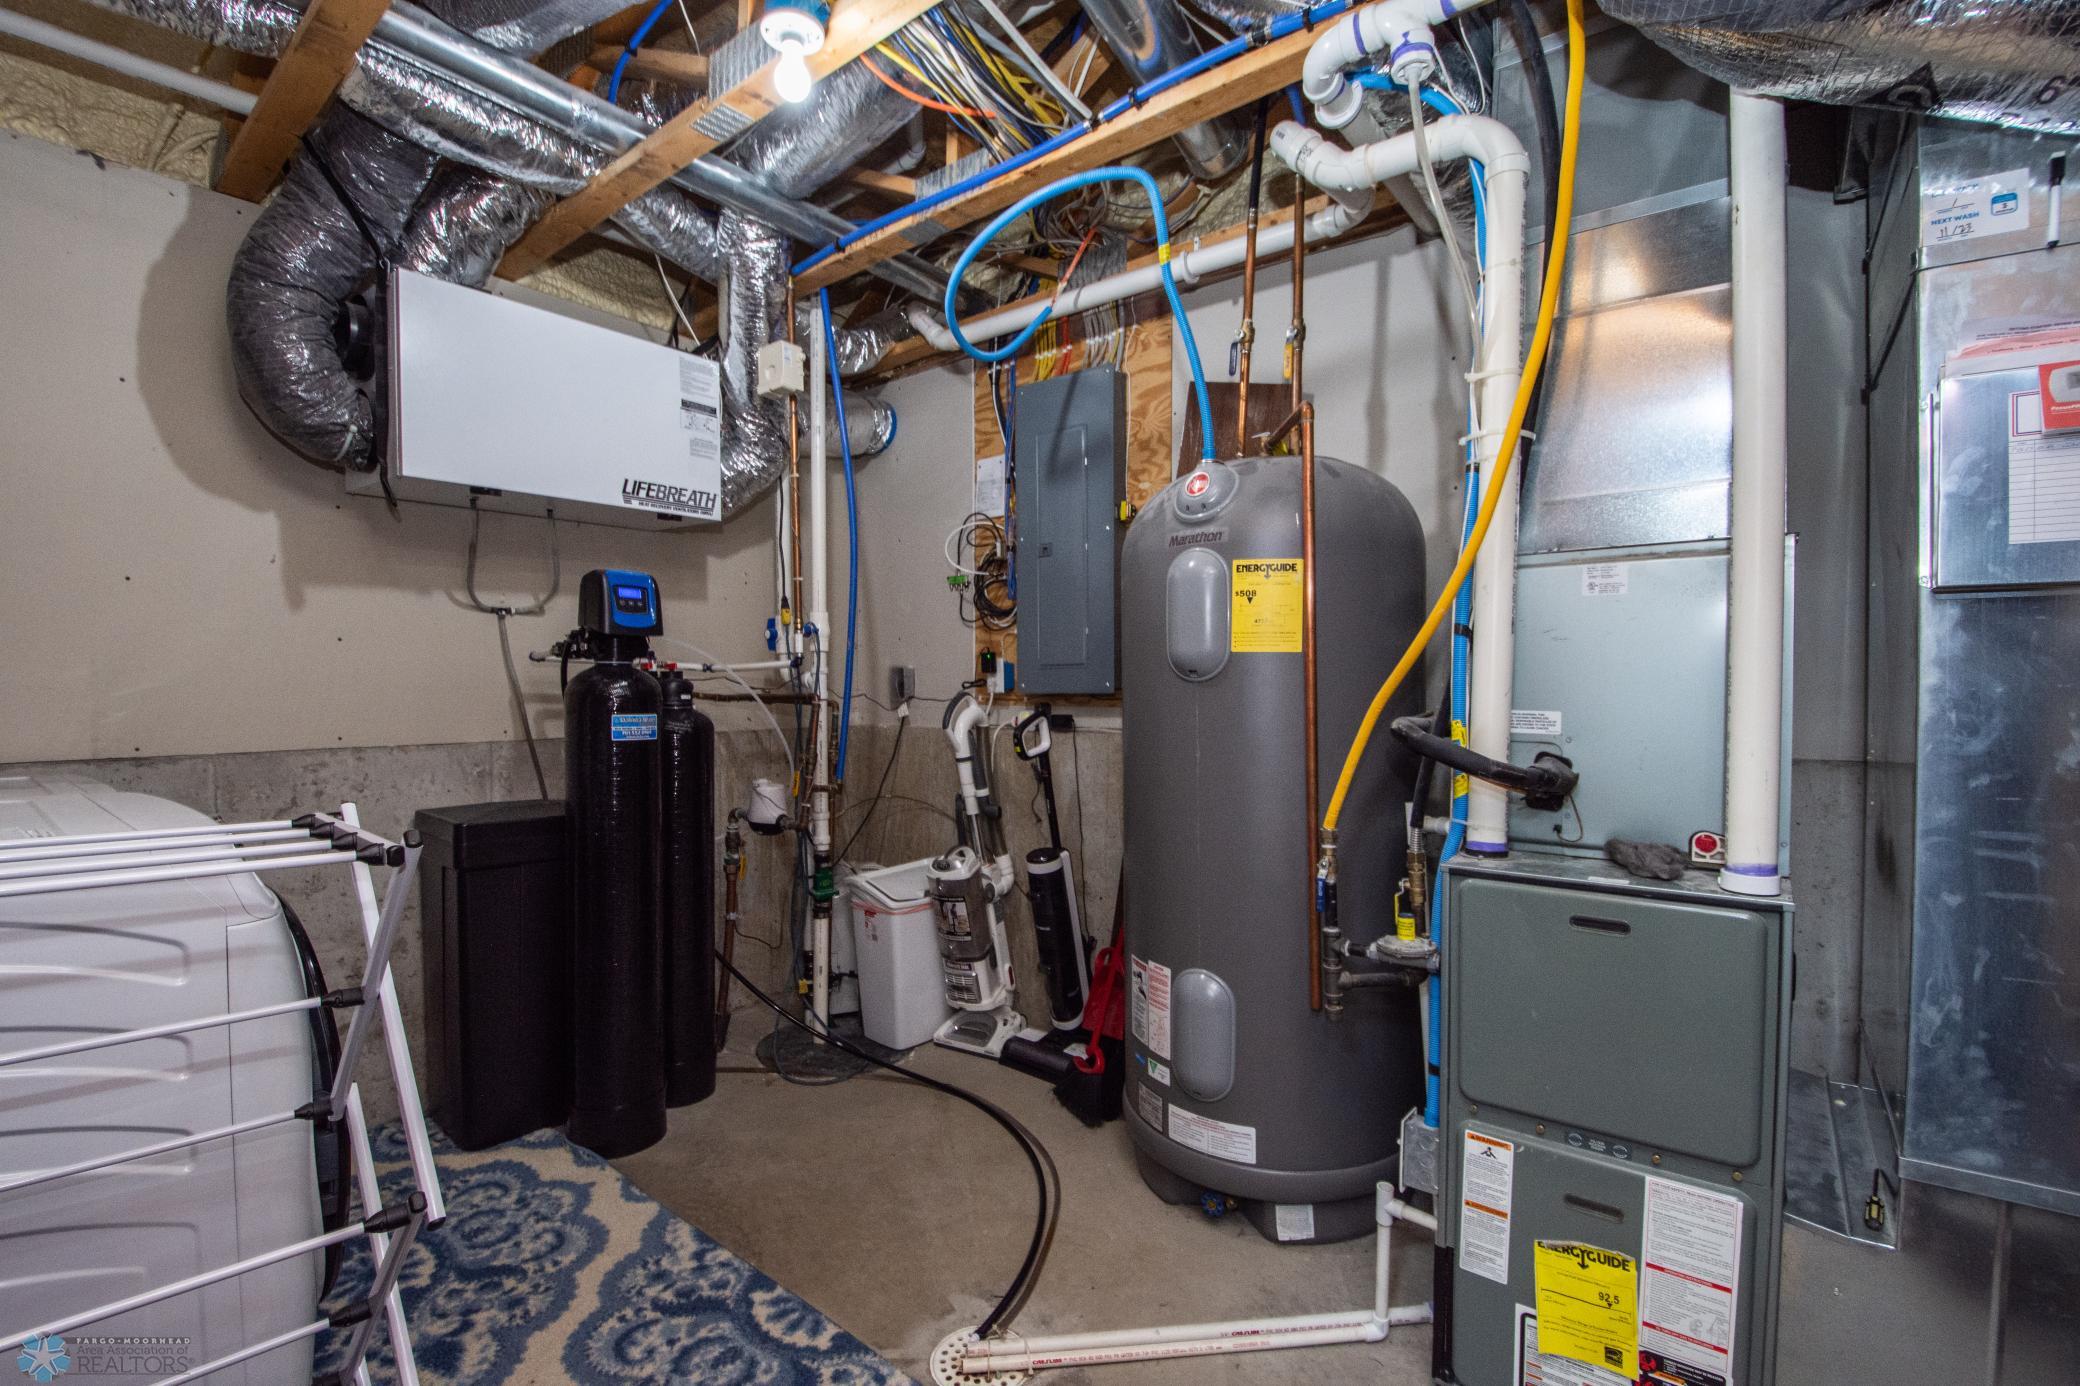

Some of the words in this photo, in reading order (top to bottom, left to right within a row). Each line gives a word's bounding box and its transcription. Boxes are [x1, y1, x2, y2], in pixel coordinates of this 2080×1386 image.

[1931, 215, 1952, 226] NEXT
[1954, 211, 1980, 222] WASH
[622, 478, 717, 509] LIFEBREATH
[1169, 531, 1223, 547] Marathon
[1598, 1291, 1620, 1305] 92.5
